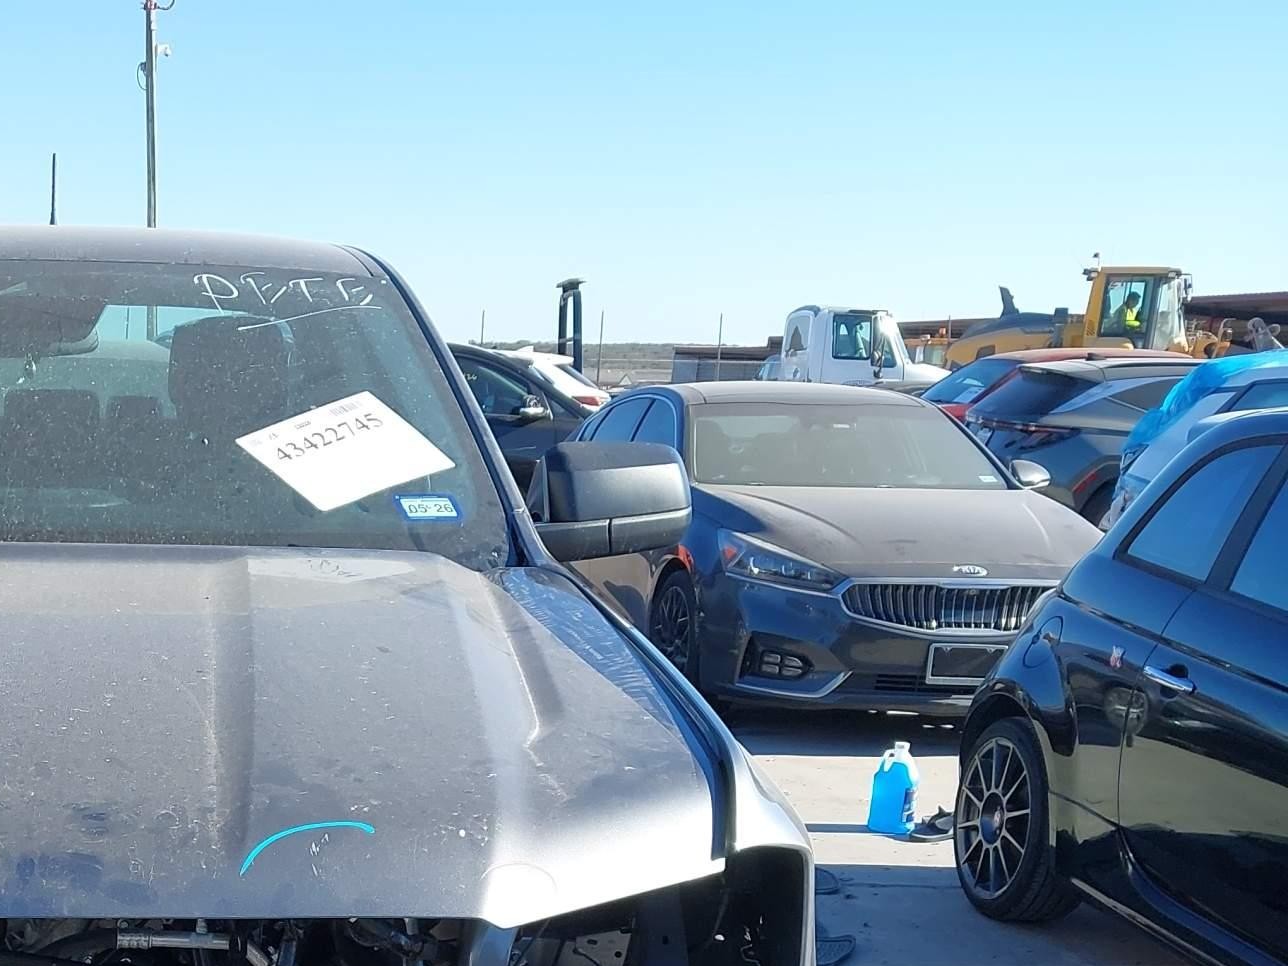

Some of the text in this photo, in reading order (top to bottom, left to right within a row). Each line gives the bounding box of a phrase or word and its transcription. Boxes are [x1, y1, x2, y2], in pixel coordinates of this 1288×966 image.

[193, 271, 375, 316] PETE
[276, 413, 384, 461] 43422745
[408, 503, 454, 514] 05 26
